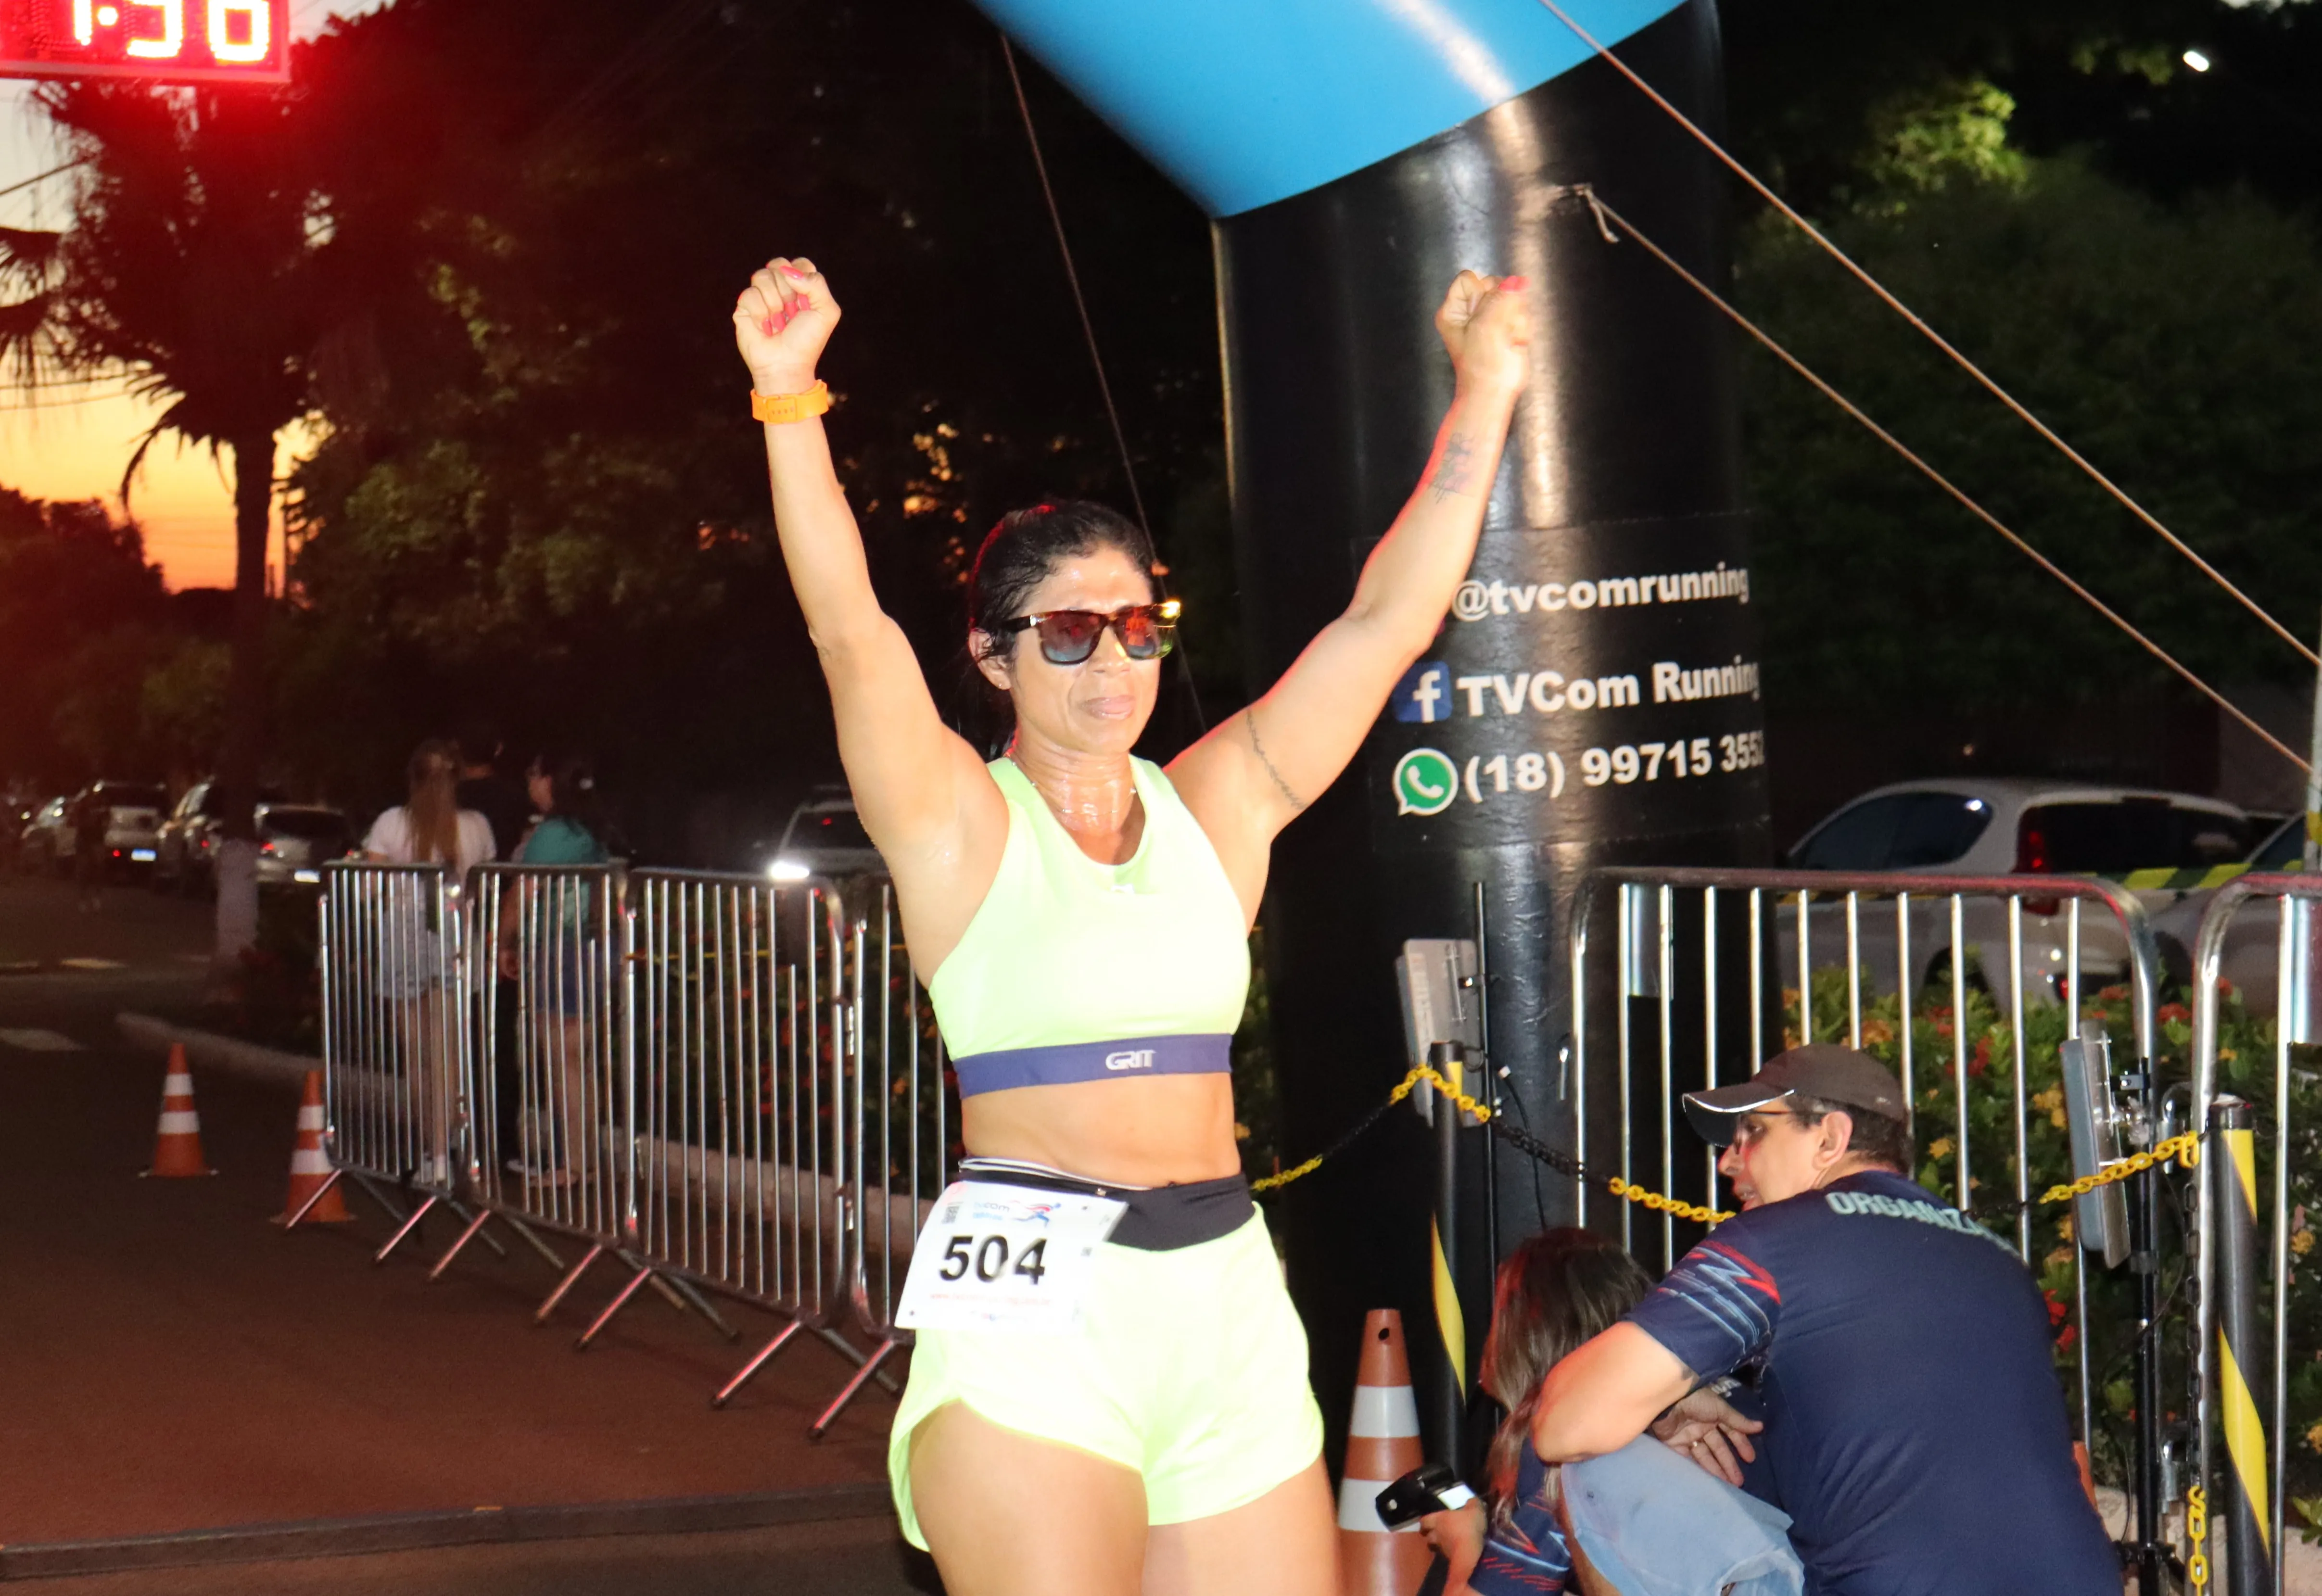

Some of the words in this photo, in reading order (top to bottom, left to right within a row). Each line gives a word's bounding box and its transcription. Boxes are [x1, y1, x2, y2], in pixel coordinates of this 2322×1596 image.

[1452, 562, 1750, 621] @tvcomrunning
[1457, 671, 1640, 718] TVCom
[1652, 655, 1760, 703] Running
[1464, 751, 1565, 804] (18)
[1580, 737, 1712, 787] 99715
[939, 1234, 1048, 1286] 504
